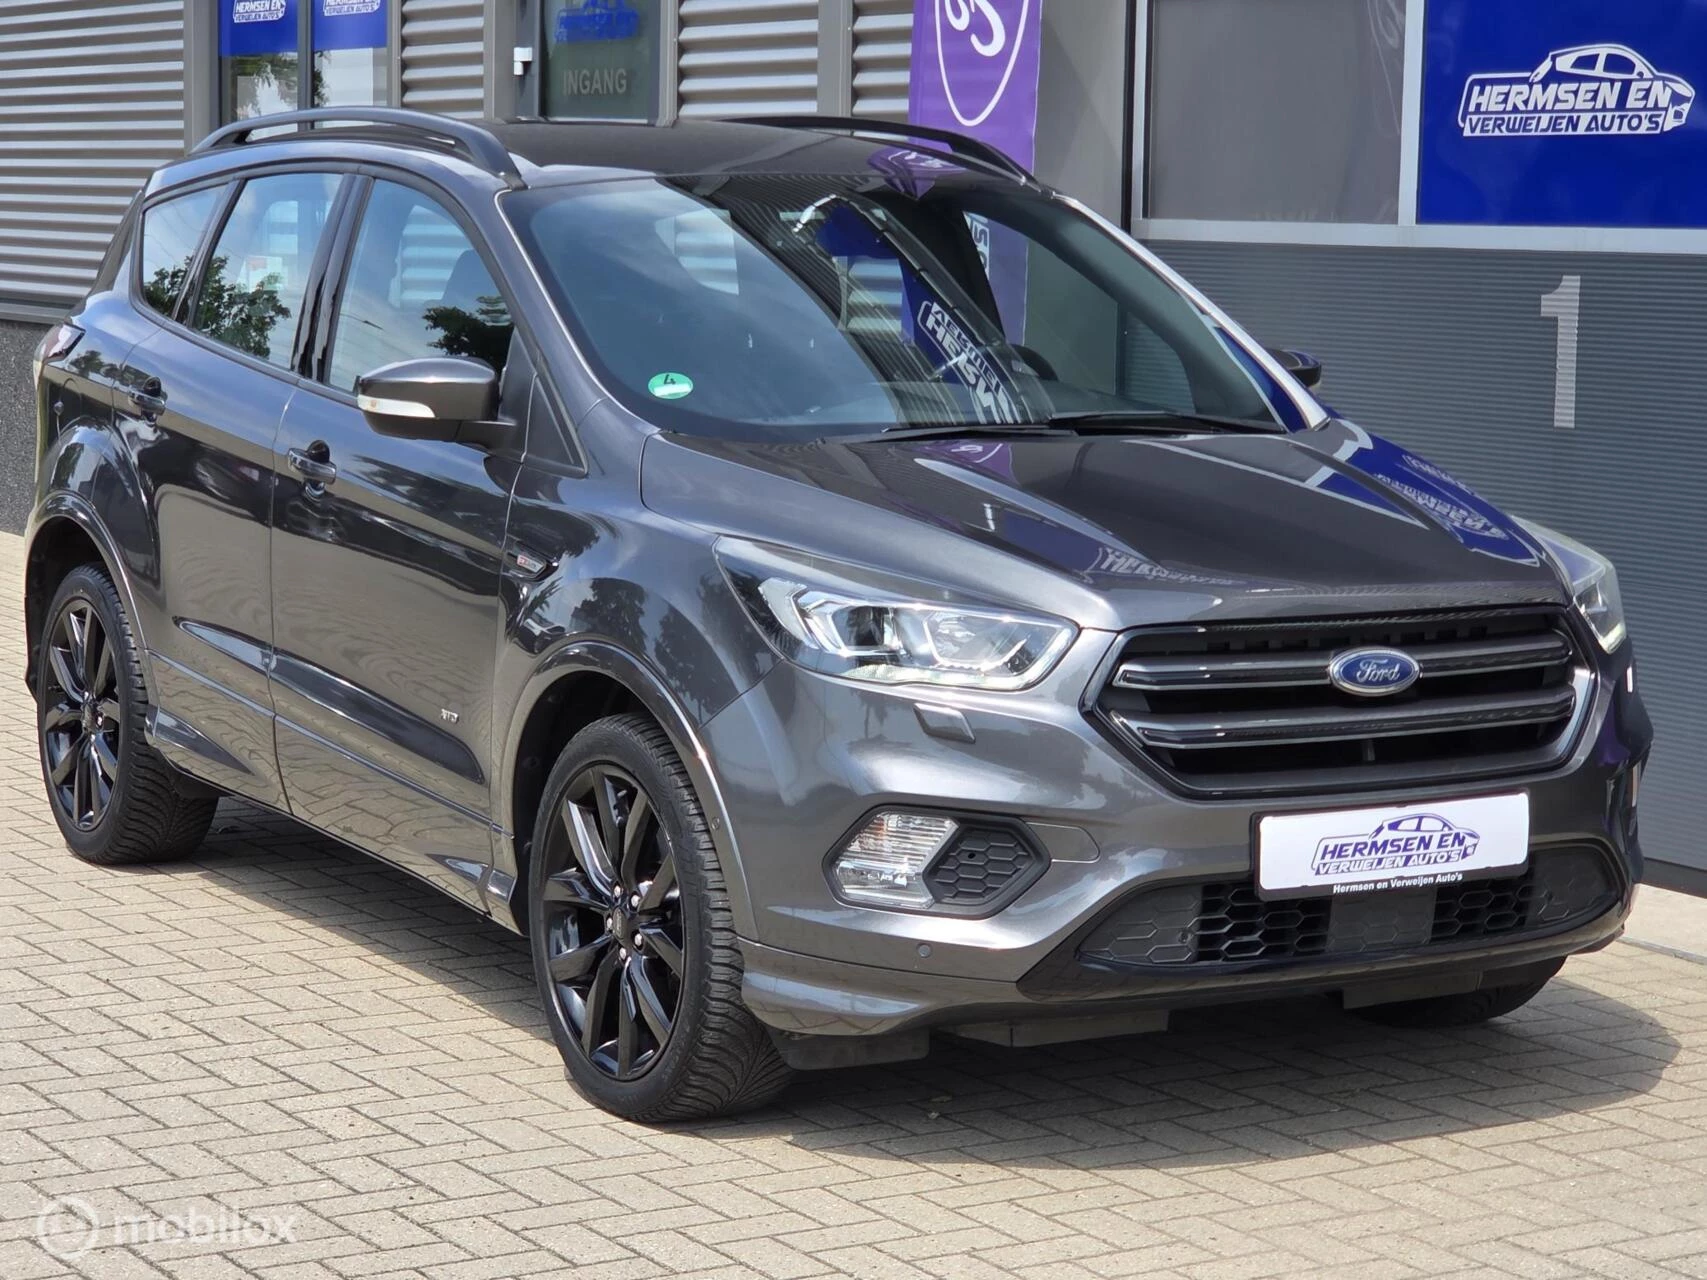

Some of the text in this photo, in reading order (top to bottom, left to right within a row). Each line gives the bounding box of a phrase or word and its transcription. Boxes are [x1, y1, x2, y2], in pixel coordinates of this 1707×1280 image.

[563, 67, 628, 96] INGANG
[1468, 80, 1672, 112] HERMSEN EN
[1467, 112, 1663, 135] VERWEIJEN AUTO'S
[1540, 274, 1581, 429] 1
[663, 373, 677, 385] 4
[1355, 658, 1401, 683] Ford
[1320, 831, 1466, 861] HERMSEN EN
[1318, 849, 1461, 875] VERWEIJEN AUTO'S
[1332, 872, 1463, 894] Hermsen en Verweijen Auto's
